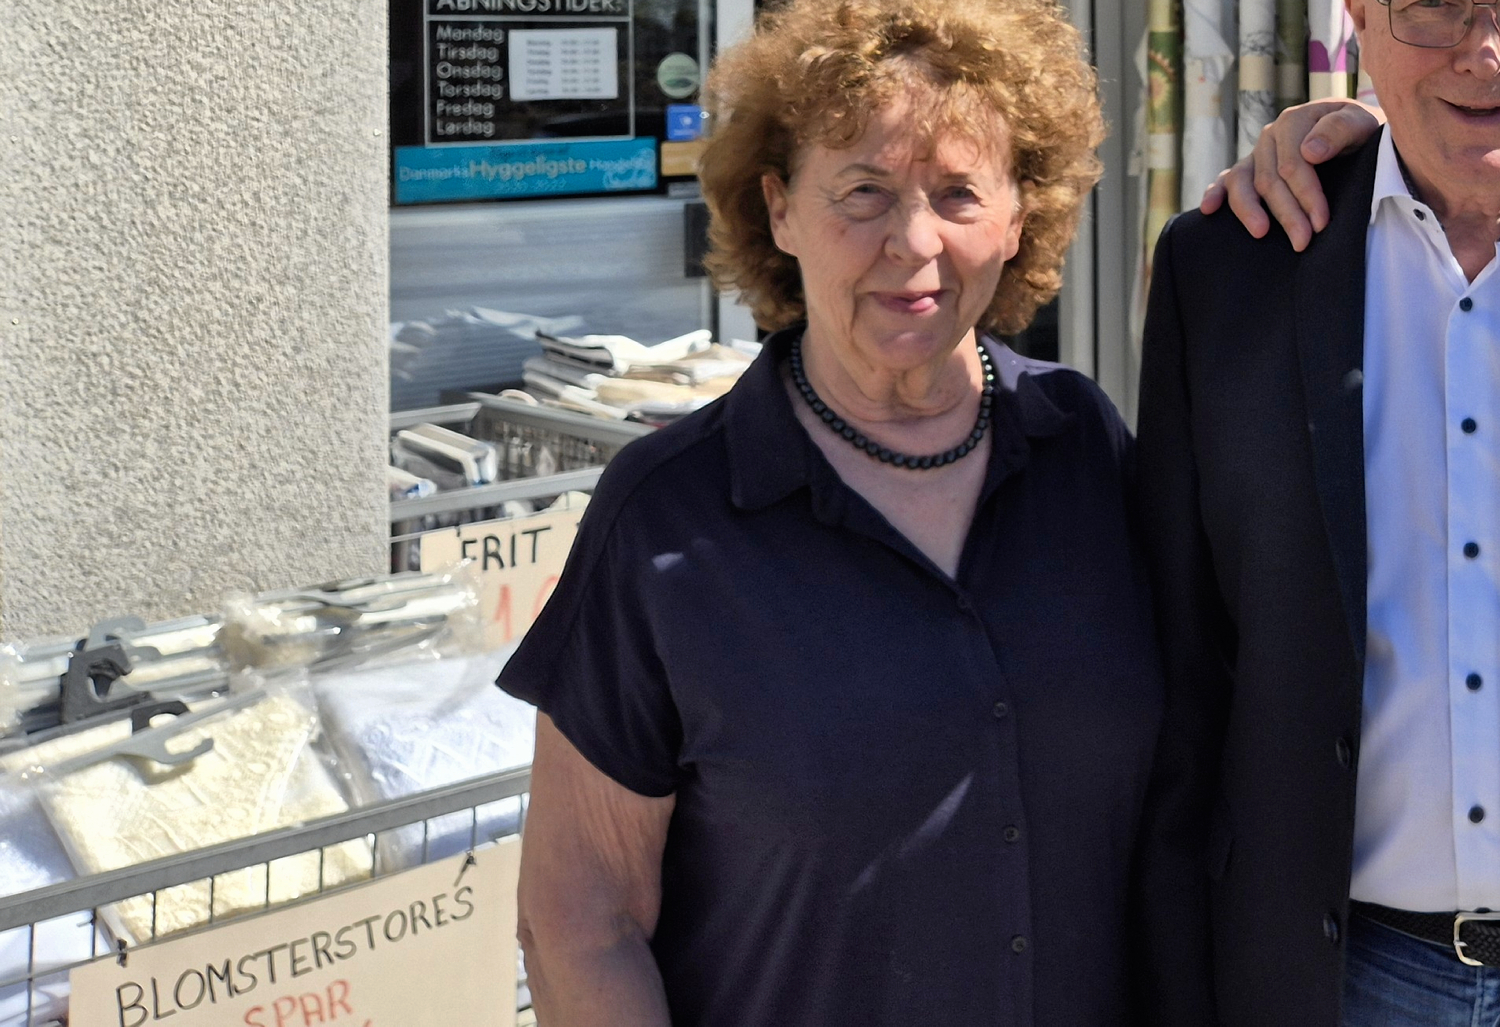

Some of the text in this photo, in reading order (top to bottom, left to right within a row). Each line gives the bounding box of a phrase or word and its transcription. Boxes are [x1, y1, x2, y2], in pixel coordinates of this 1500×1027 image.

[436, 24, 505, 44] Mandag
[436, 43, 500, 63] Tirsdag
[436, 61, 504, 81] Onsdag
[436, 80, 504, 100] Torsdag
[436, 99, 496, 119] Fredag
[461, 526, 553, 571] FRIT
[116, 885, 475, 1027] BLOMSTERSTORES
[244, 978, 354, 1027] SPAR
